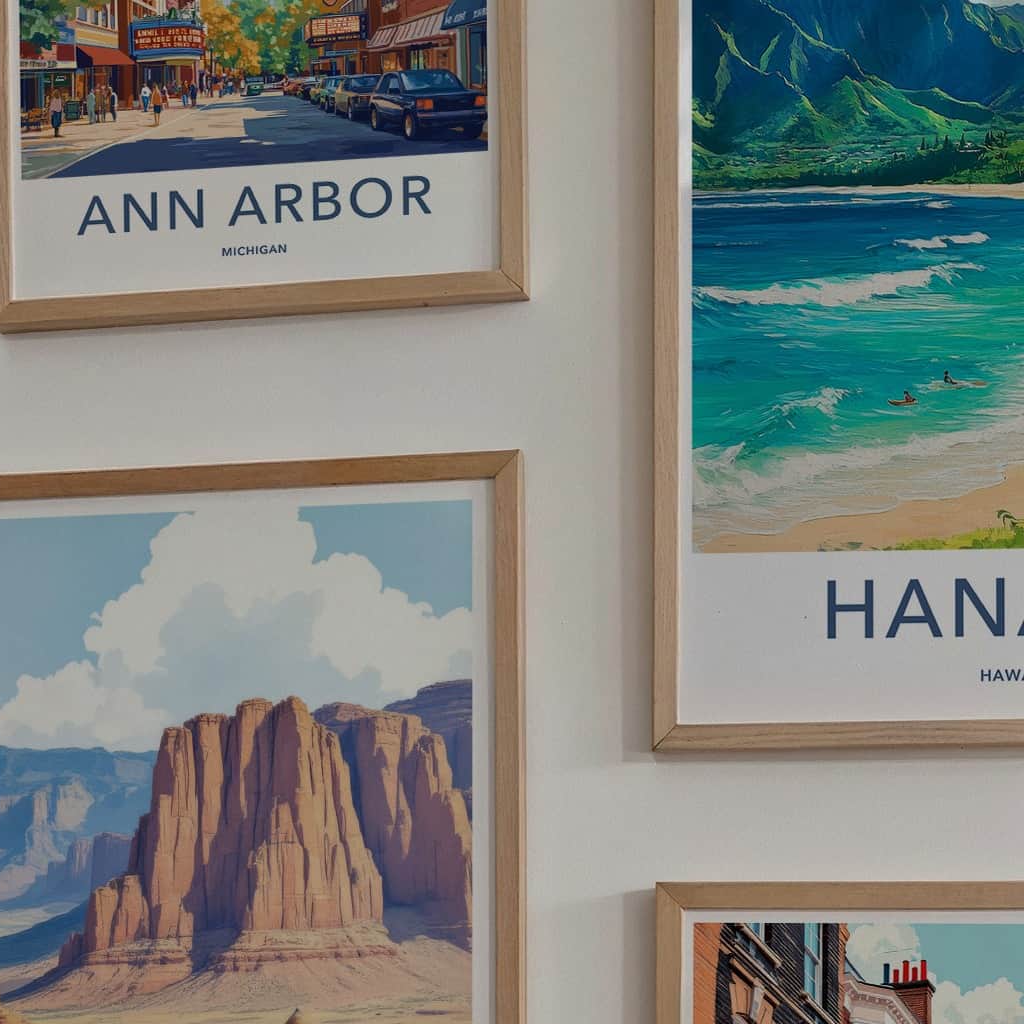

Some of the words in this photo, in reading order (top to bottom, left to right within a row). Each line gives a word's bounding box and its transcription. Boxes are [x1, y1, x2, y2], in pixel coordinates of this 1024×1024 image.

[77, 189, 204, 236] ANN
[228, 175, 432, 227] ARBOR
[221, 244, 288, 257] MICHIGAN
[826, 577, 1024, 639] HAN
[980, 669, 1024, 682] HAW
